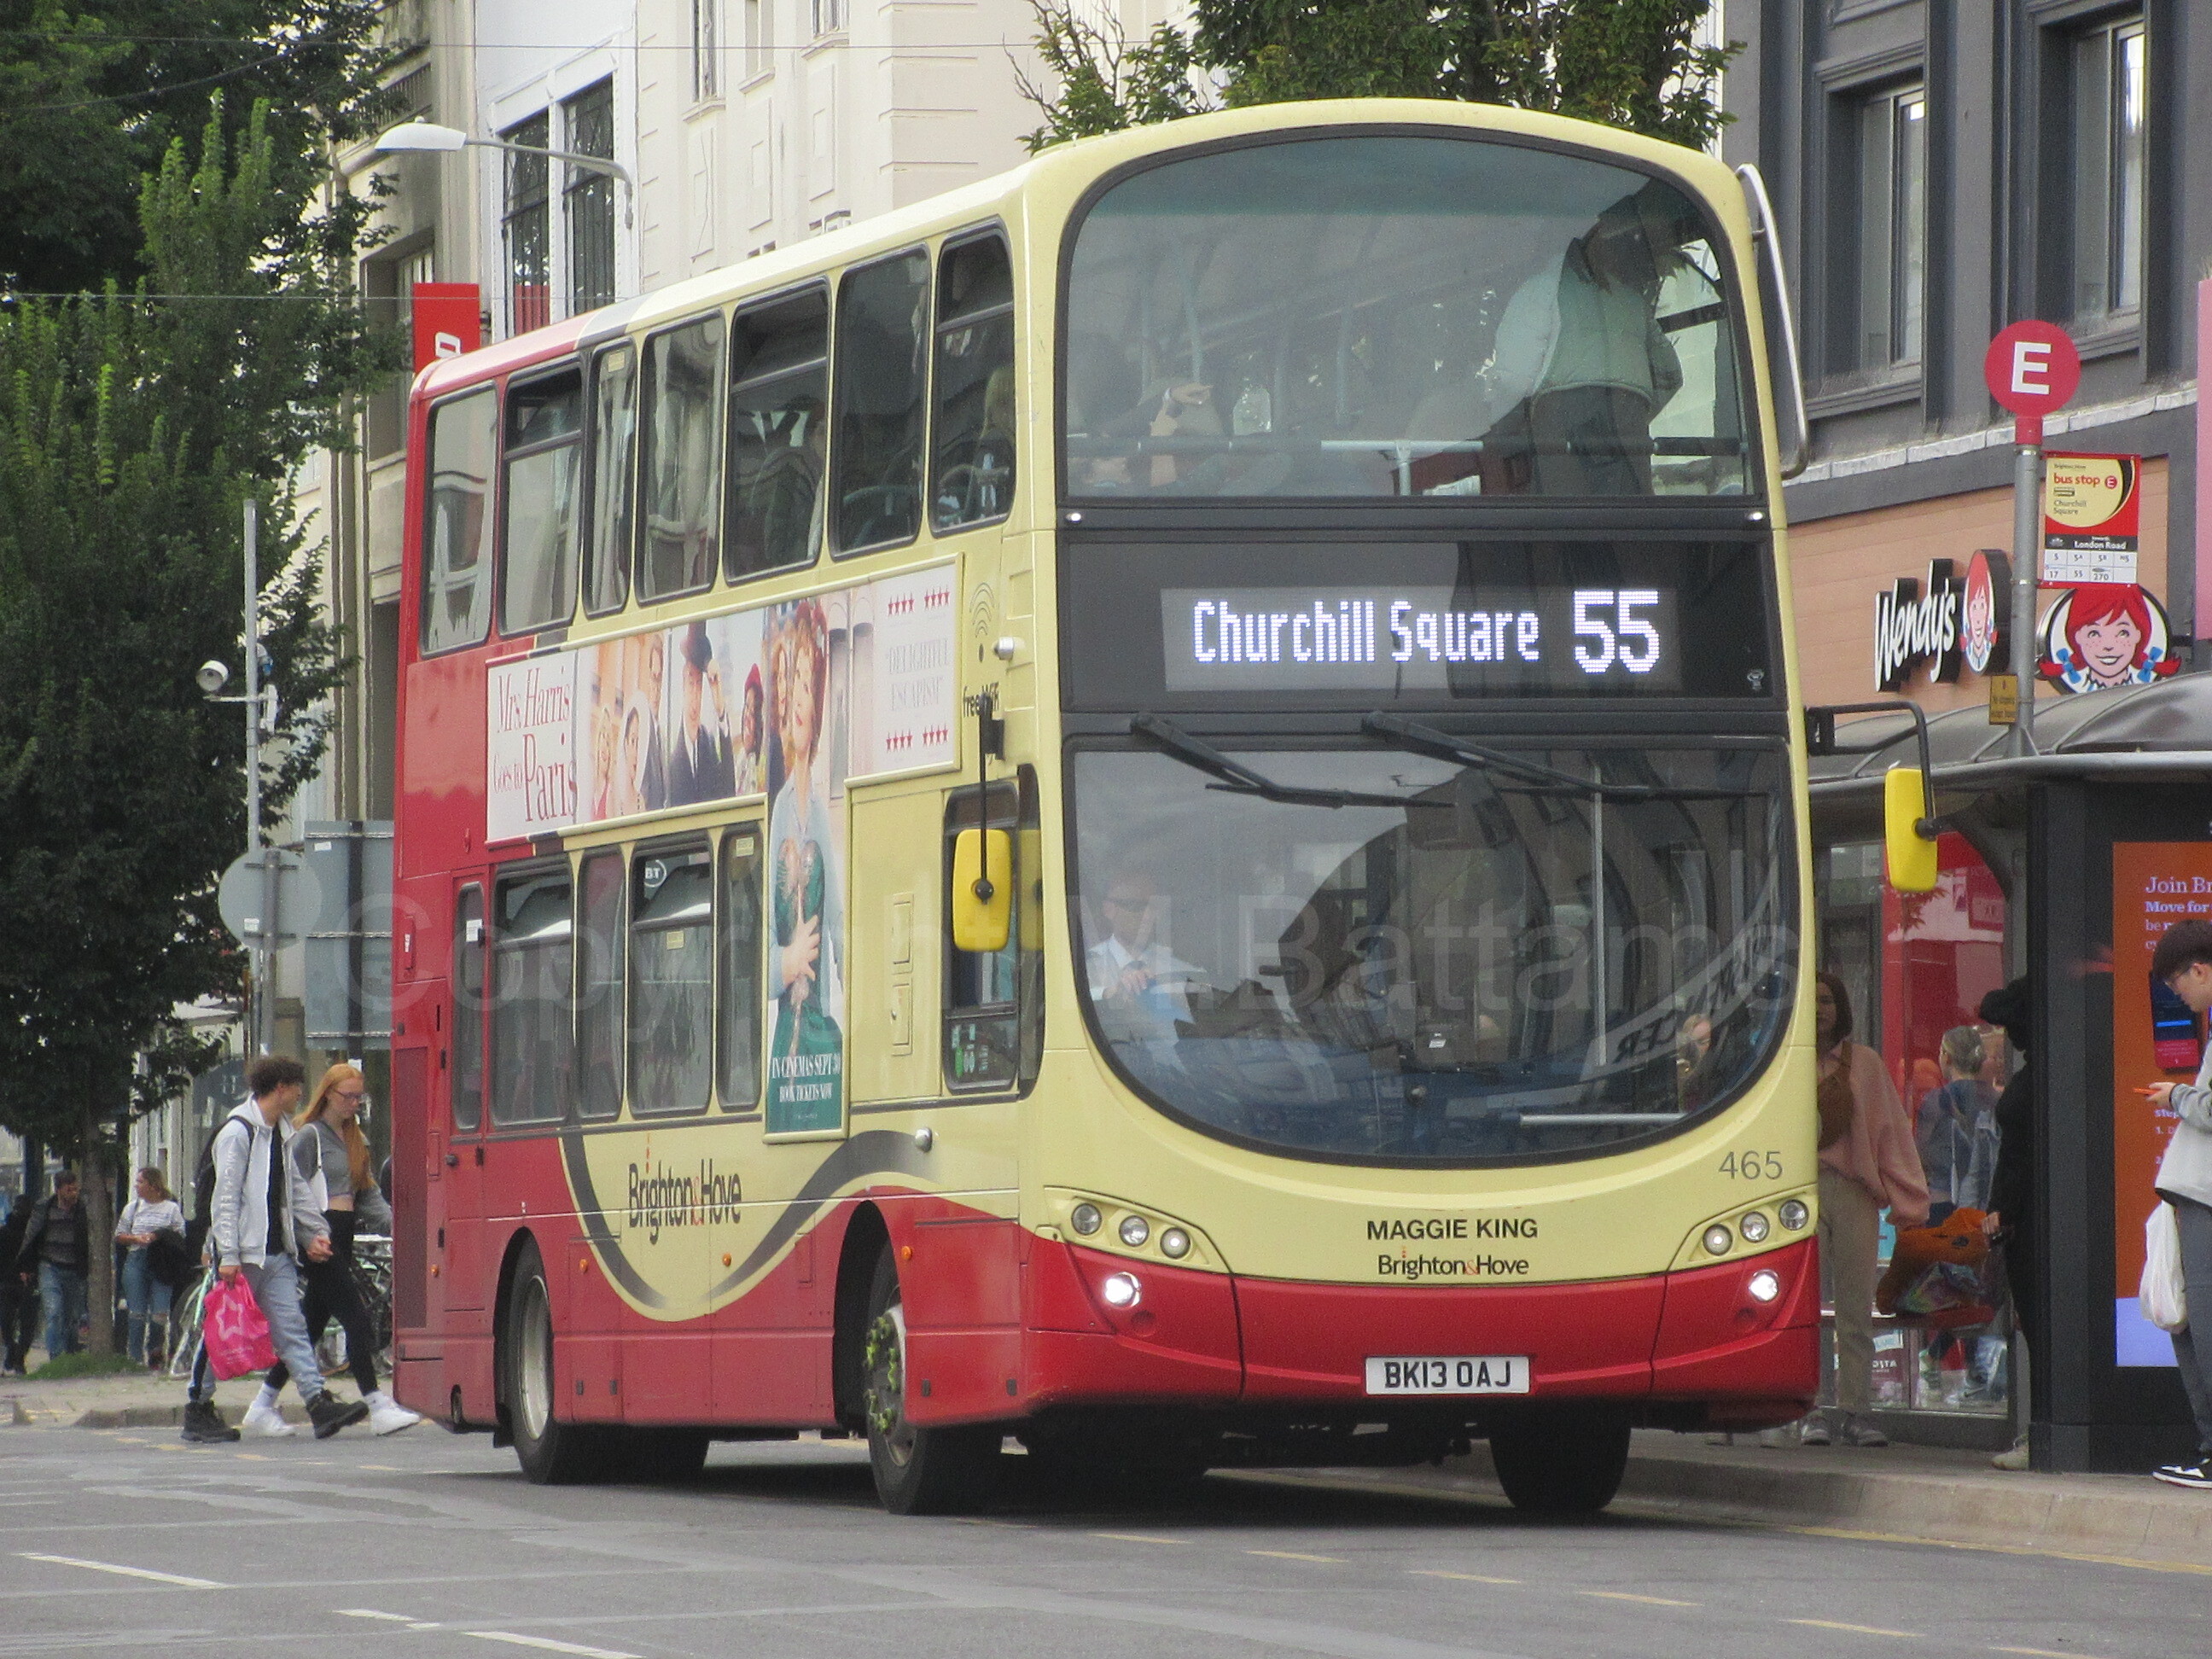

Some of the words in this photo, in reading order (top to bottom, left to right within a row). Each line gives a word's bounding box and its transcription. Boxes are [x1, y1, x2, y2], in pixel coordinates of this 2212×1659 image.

[2011, 341, 2052, 395] E
[2053, 473, 2073, 485] bus
[2075, 474, 2101, 487] stop
[2106, 478, 2116, 486] E
[2053, 552, 2059, 561] 5
[2074, 540, 2104, 549] London
[2104, 541, 2127, 550] Road
[2049, 570, 2058, 579] 17
[2093, 573, 2110, 581] 270
[1194, 601, 1375, 662] Churchill
[1390, 600, 1540, 662] Square
[1575, 590, 1661, 673] 55
[1875, 559, 1956, 692] Wendy's
[498, 672, 521, 734] Mrs
[523, 666, 571, 730] Harris
[493, 753, 512, 795] Goes
[522, 731, 579, 823] Paris
[2145, 876, 2188, 894] Join
[2191, 876, 2212, 894] Br
[2145, 900, 2185, 913] Move
[2186, 900, 2209, 913] for
[2145, 919, 2161, 931] be
[772, 1057, 781, 1079] IN
[781, 1054, 814, 1078] CINEMAS
[814, 1053, 833, 1075] SEPT
[1719, 1150, 1783, 1180] 465
[628, 1157, 742, 1246] Brighton&Hove
[1367, 1219, 1469, 1240] MAGGIE
[1476, 1218, 1538, 1239] KING
[1377, 1252, 1529, 1280] Brighton&Hove
[1383, 1360, 1448, 1388] BK13
[1456, 1360, 1511, 1388] OAJ
